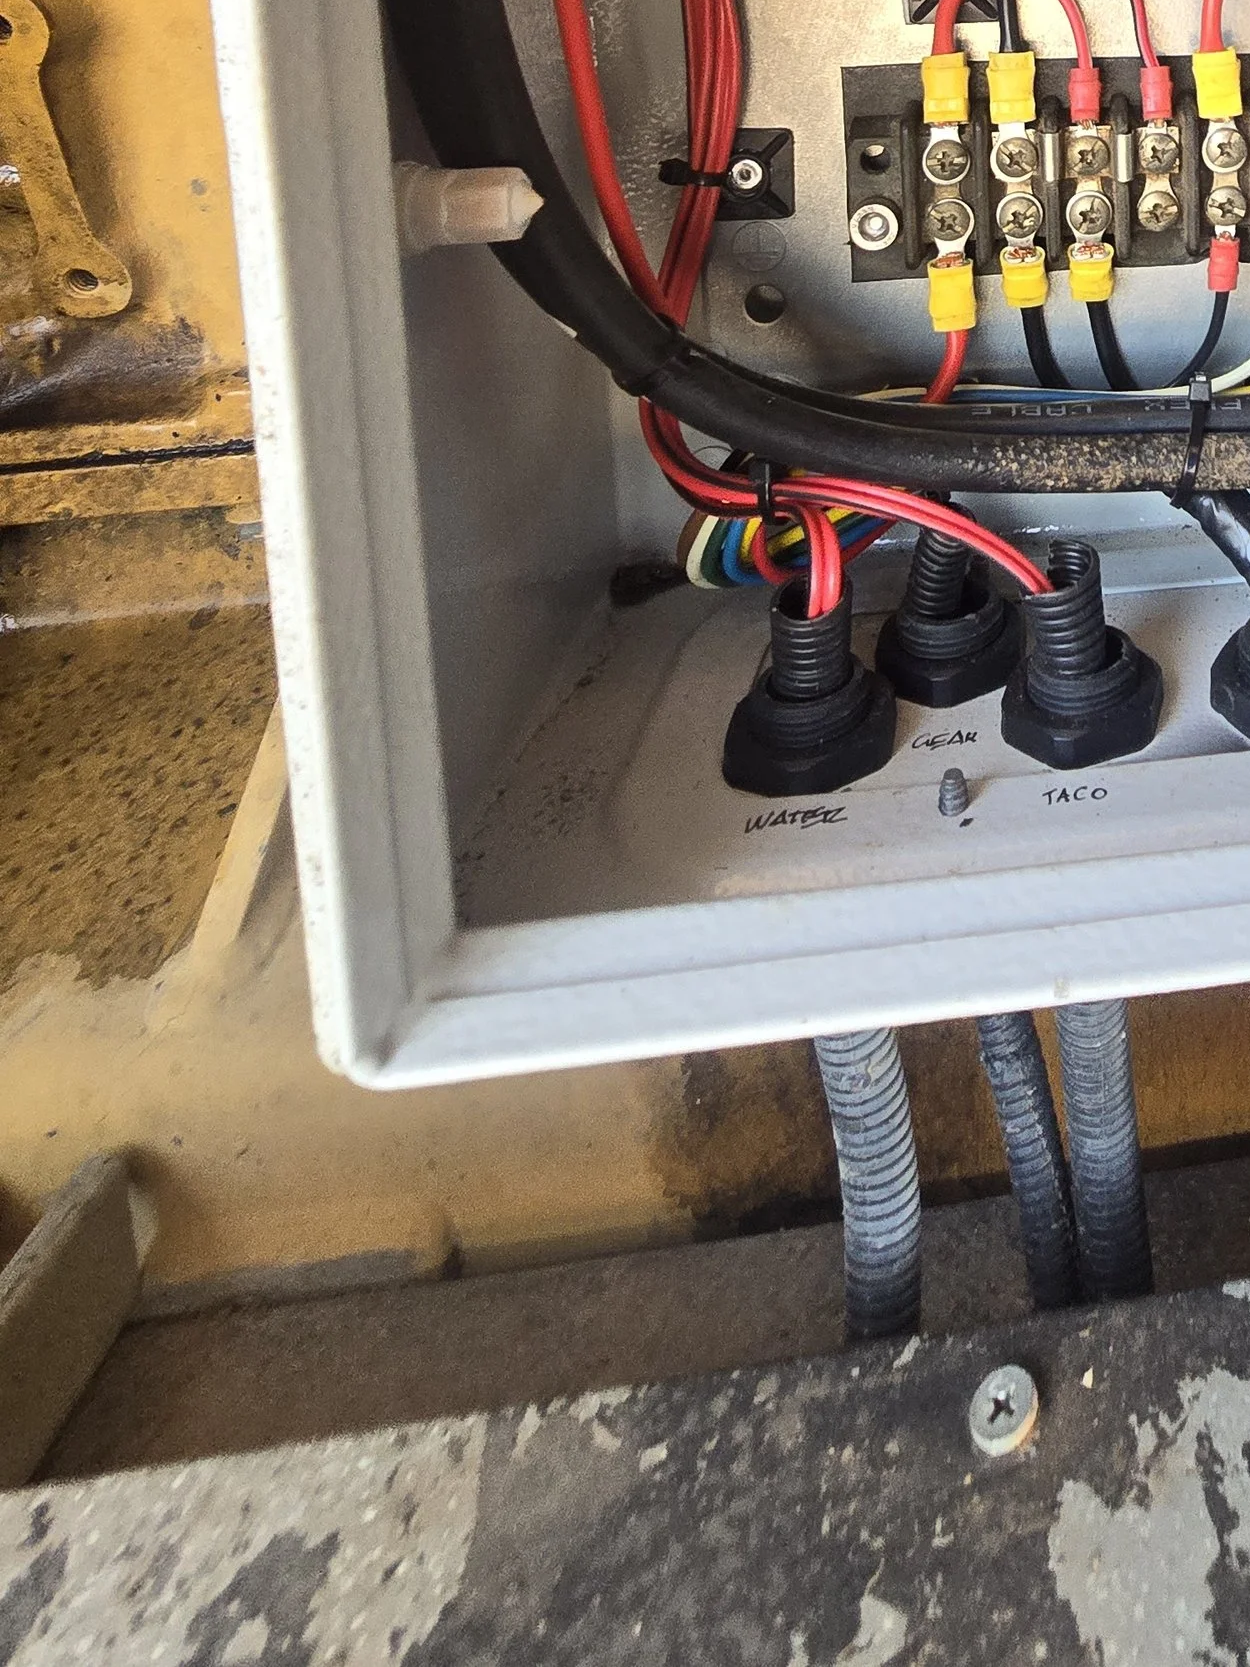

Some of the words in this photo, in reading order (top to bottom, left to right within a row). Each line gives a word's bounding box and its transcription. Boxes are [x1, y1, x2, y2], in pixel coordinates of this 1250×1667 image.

[912, 730, 978, 751] GEAR
[1042, 786, 1108, 806] TACO
[744, 805, 849, 834] WATER
